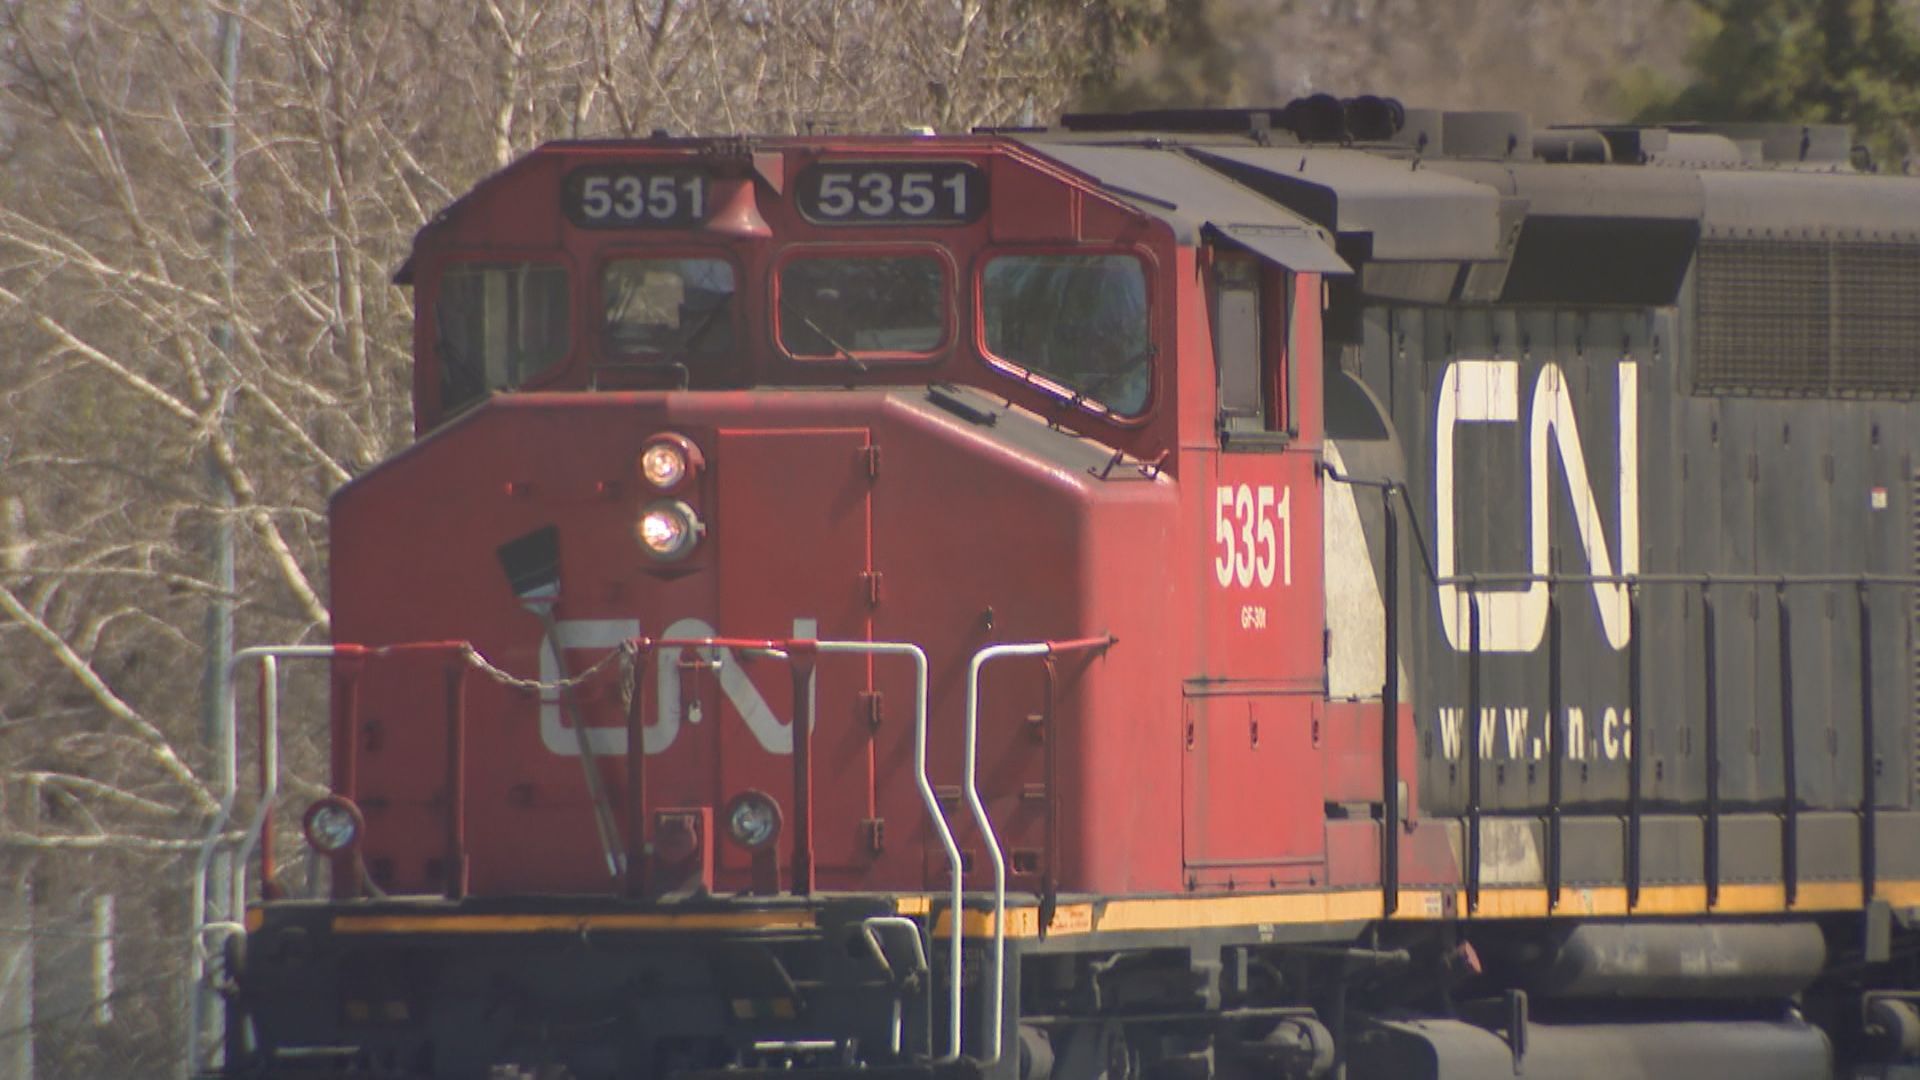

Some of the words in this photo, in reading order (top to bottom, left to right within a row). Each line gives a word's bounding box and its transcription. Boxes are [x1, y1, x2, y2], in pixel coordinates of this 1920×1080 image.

[582, 175, 705, 219] 5351
[818, 174, 968, 217] 5351
[1215, 484, 1292, 589] 5351
[1435, 361, 1638, 652] CN
[539, 619, 817, 755] CN
